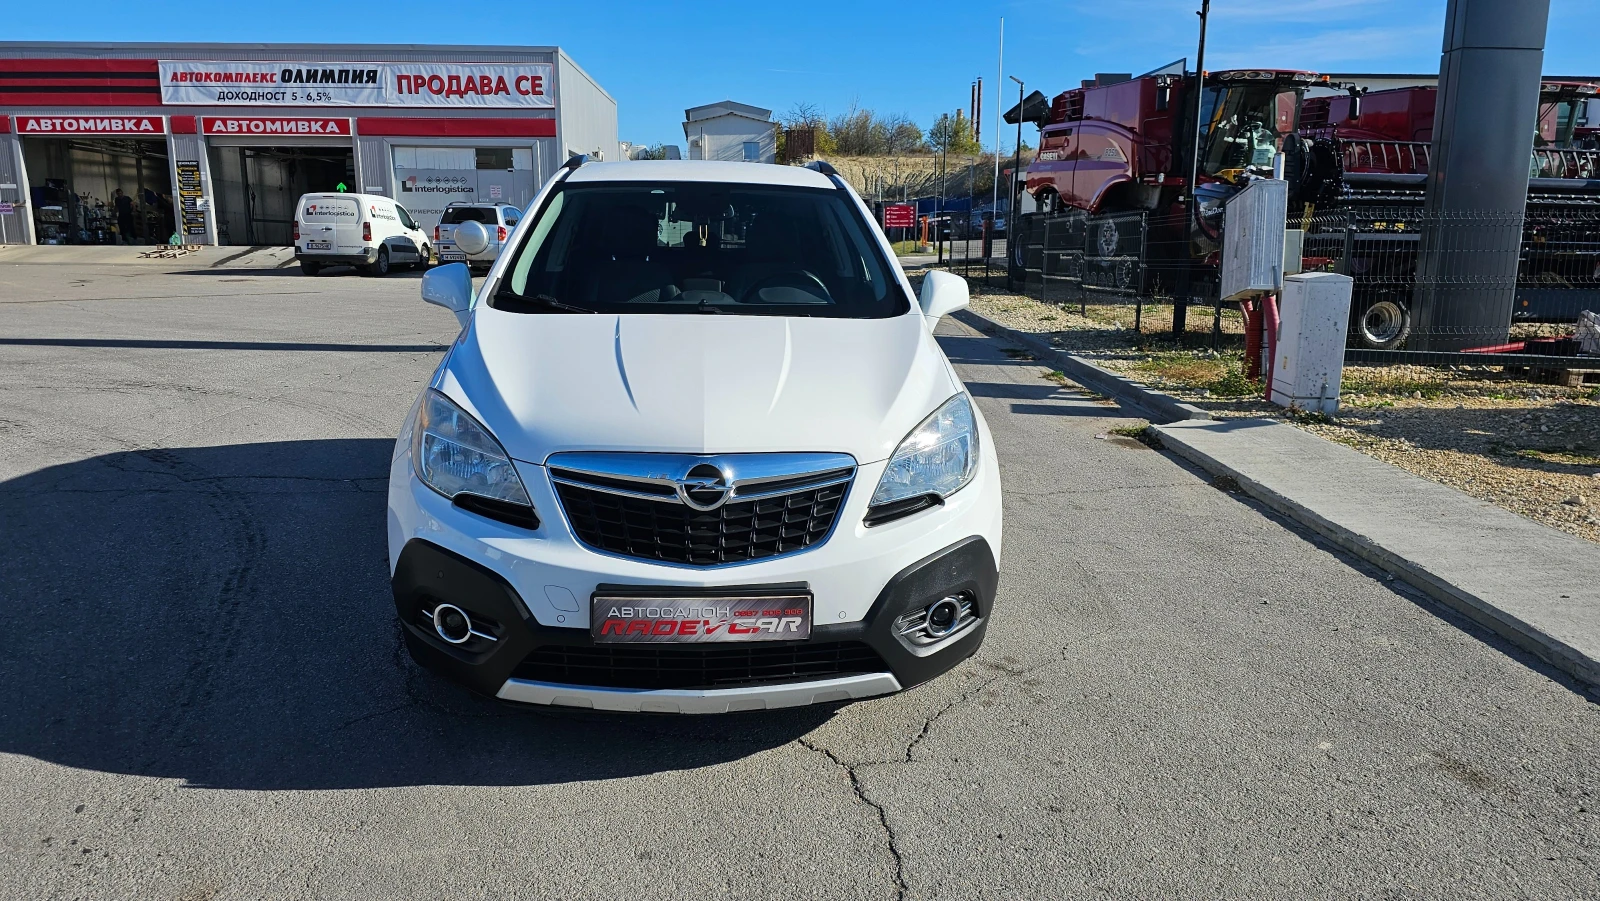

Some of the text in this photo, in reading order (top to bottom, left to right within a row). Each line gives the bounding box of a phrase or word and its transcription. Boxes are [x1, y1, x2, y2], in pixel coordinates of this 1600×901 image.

[170, 68, 378, 83] АВТОКОМПЛЕКС ОЛИМПИЯ
[396, 74, 544, 98] ПРОДАВА СЕ
[217, 91, 287, 102] ДОХОДНОСТ
[291, 92, 298, 101] 5
[306, 91, 332, 102] 6,5%
[25, 118, 154, 131] АВТОМИВКА
[211, 119, 340, 133] АВТОМИВКА
[415, 185, 474, 194] interlogistica
[607, 606, 730, 618] АВТОСАЛОН
